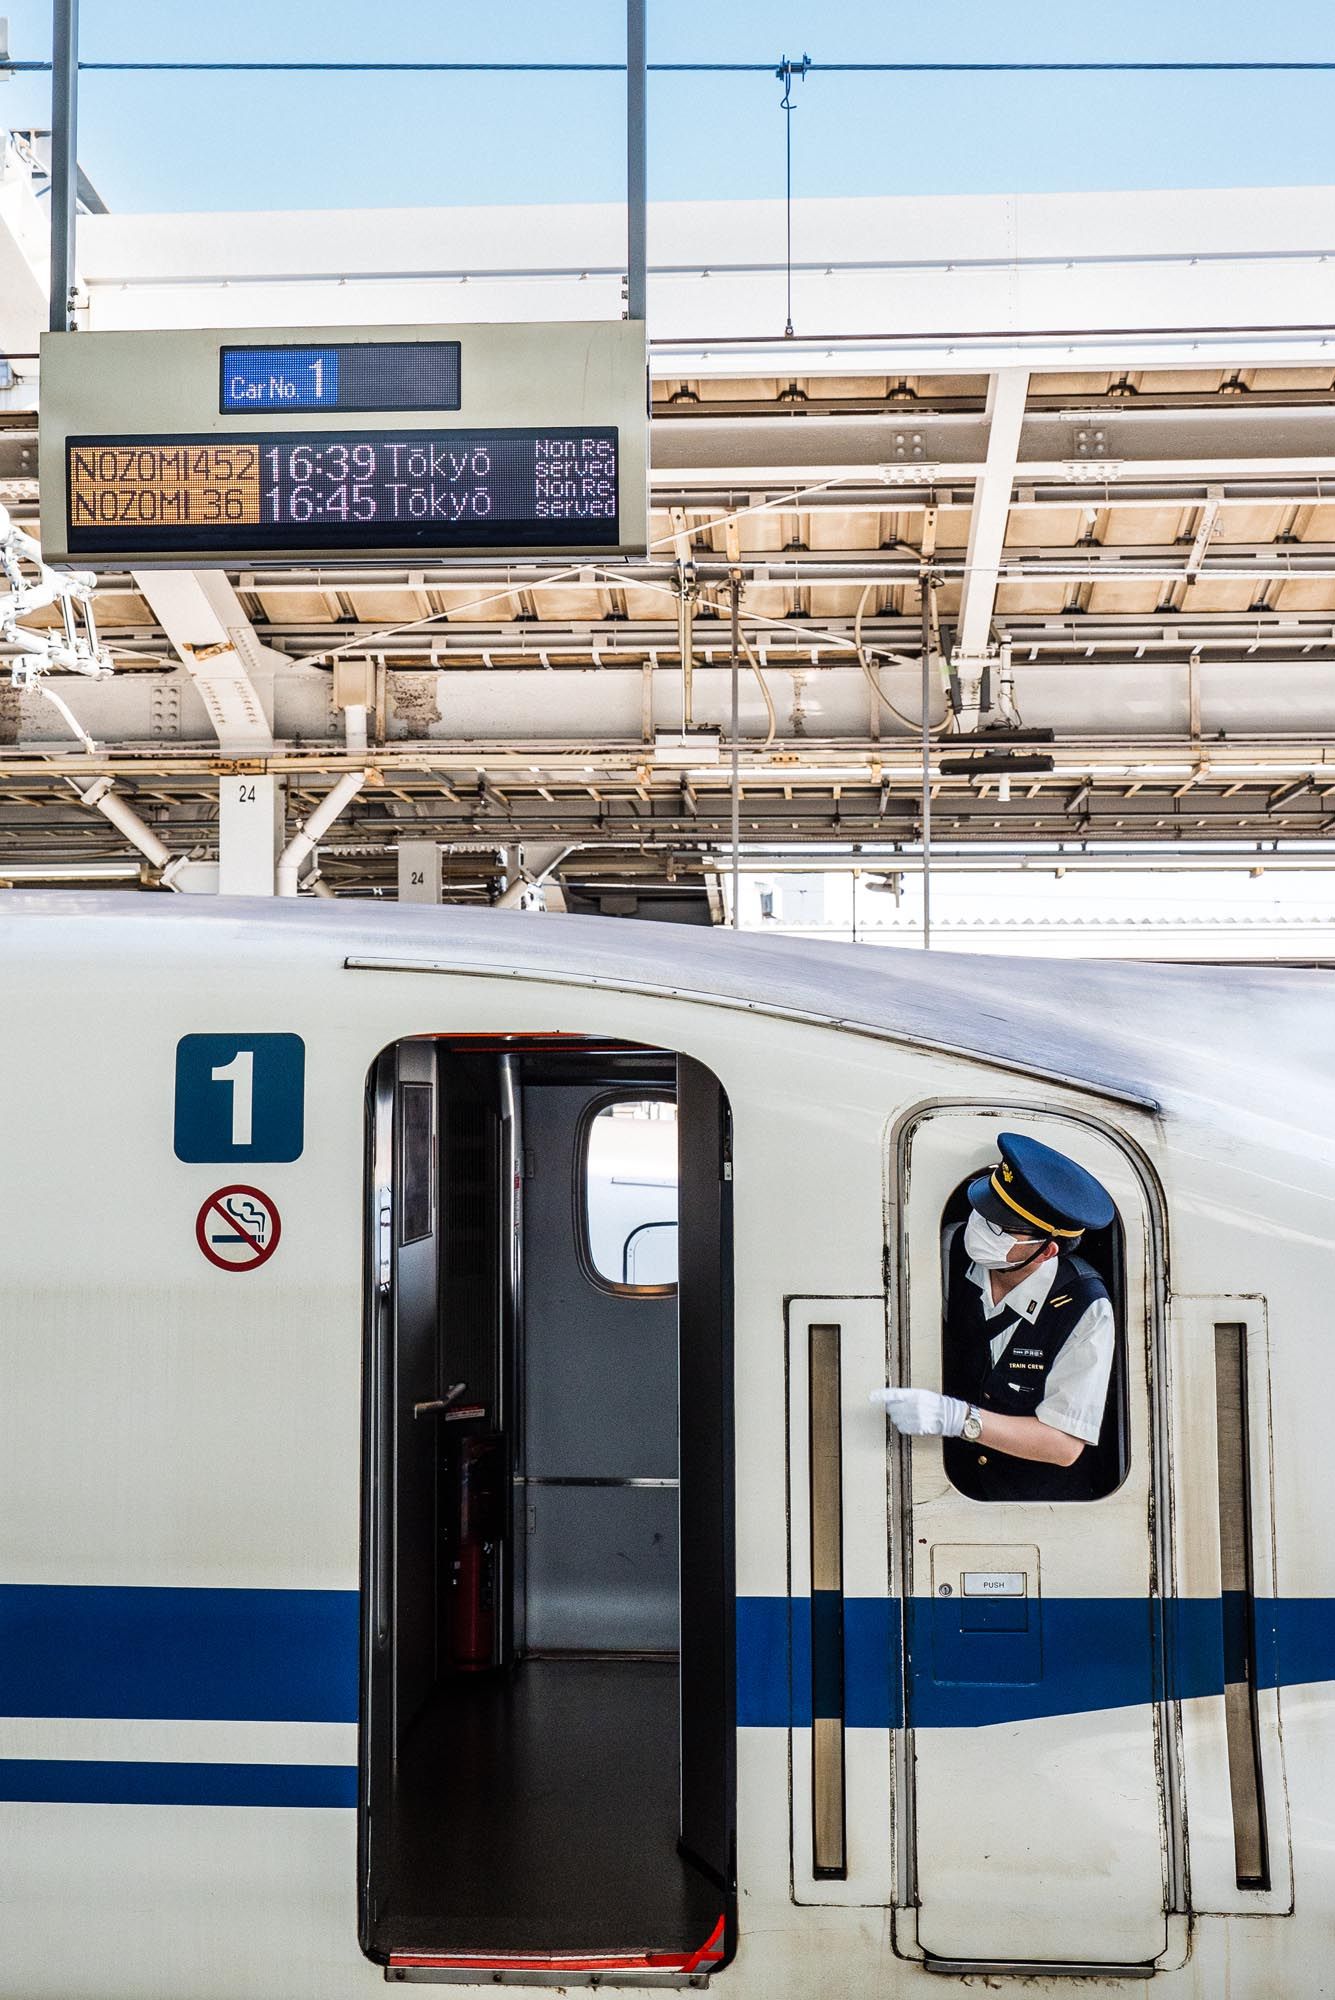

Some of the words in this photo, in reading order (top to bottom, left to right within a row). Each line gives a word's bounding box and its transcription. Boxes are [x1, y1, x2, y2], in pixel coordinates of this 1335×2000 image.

[231, 377, 266, 400] Car
[269, 376, 300, 399] No.
[308, 358, 323, 399] 1
[535, 439, 576, 457] Non
[265, 445, 376, 483] 16:39
[384, 444, 491, 482] Tōkyō
[535, 456, 615, 478] served
[535, 479, 577, 497] Non
[75, 489, 190, 522] NOZOMI
[202, 488, 243, 521] 36
[265, 484, 377, 522] 16:45
[385, 482, 491, 521] Tōkyō
[535, 495, 616, 517] served
[239, 784, 256, 803] 24
[411, 871, 424, 886] 24
[211, 1051, 254, 1145] 1
[983, 1581, 1005, 1589] PUSH
